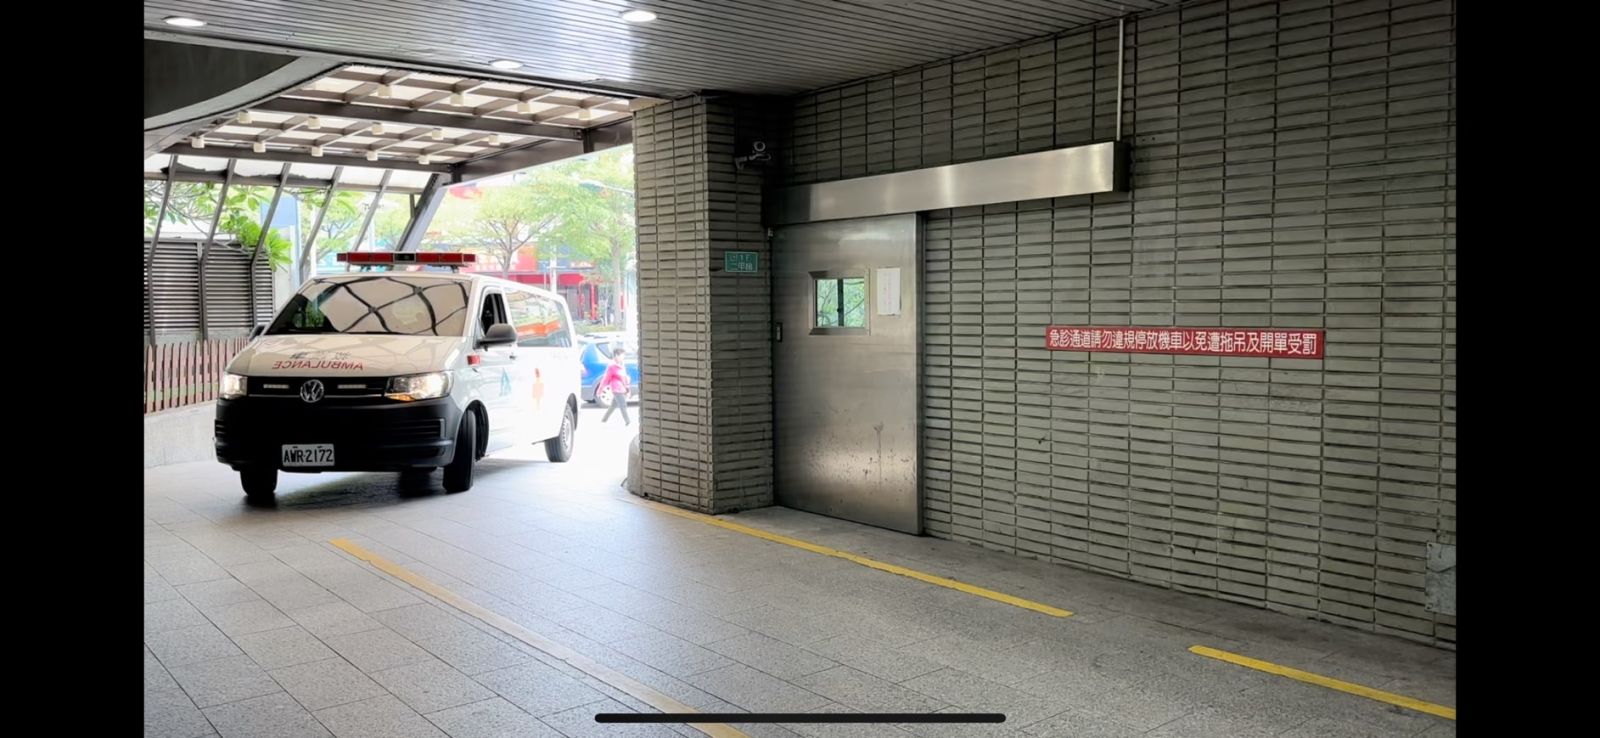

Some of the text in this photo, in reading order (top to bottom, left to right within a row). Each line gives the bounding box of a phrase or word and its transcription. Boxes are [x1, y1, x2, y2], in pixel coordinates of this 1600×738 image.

[1049, 329, 1317, 355] 急診通道請勿違規停放機車以免遭拖吊及開單受罰
[283, 449, 333, 462] AWR-2172
